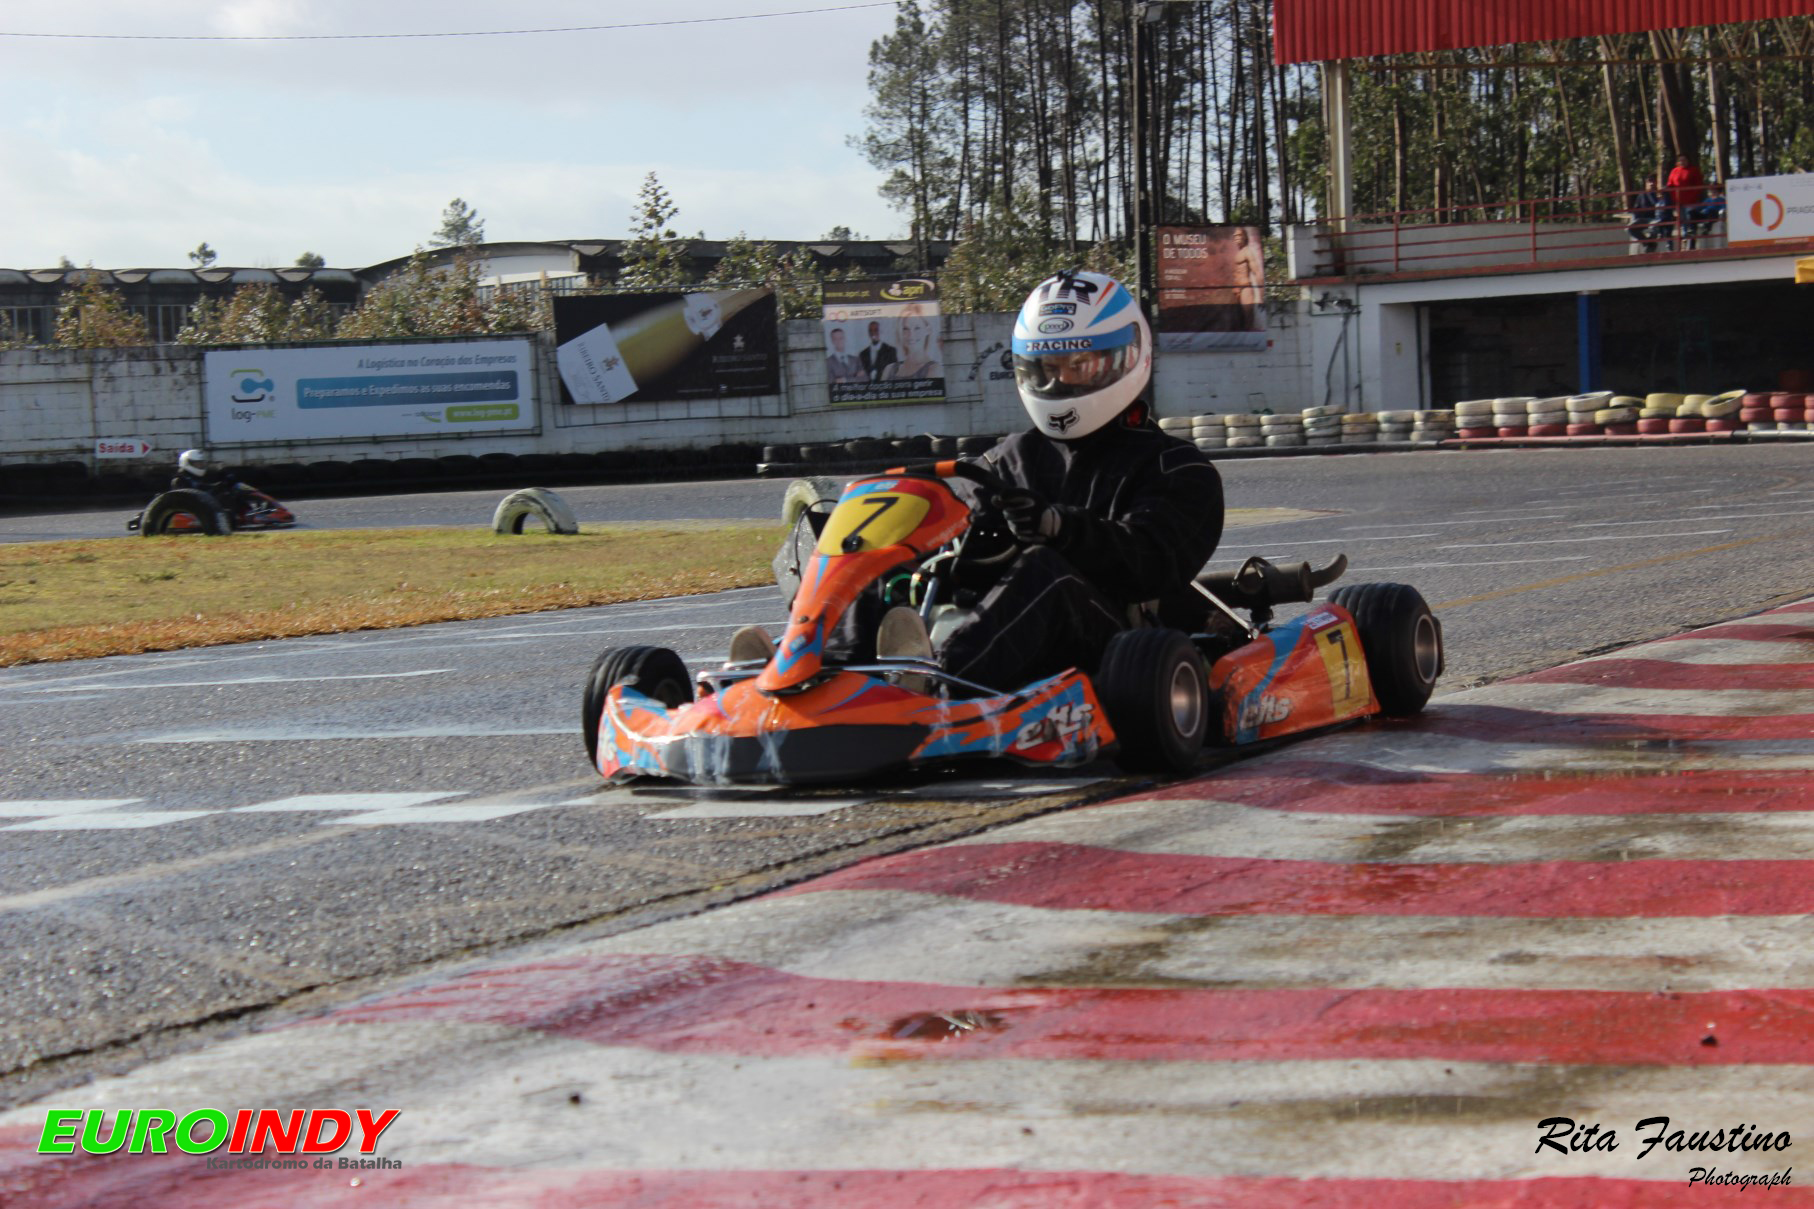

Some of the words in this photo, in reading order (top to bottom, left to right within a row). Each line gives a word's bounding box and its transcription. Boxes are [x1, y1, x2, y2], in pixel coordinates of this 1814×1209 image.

[1173, 233, 1207, 245] MUSEU
[1163, 247, 1176, 259] DE
[1177, 247, 1209, 259] TODOS
[903, 283, 925, 297] apri
[1031, 339, 1093, 352] RACING
[357, 358, 364, 369] A
[475, 353, 517, 367] Empresas
[847, 496, 900, 543] 7
[1326, 629, 1351, 700] 7
